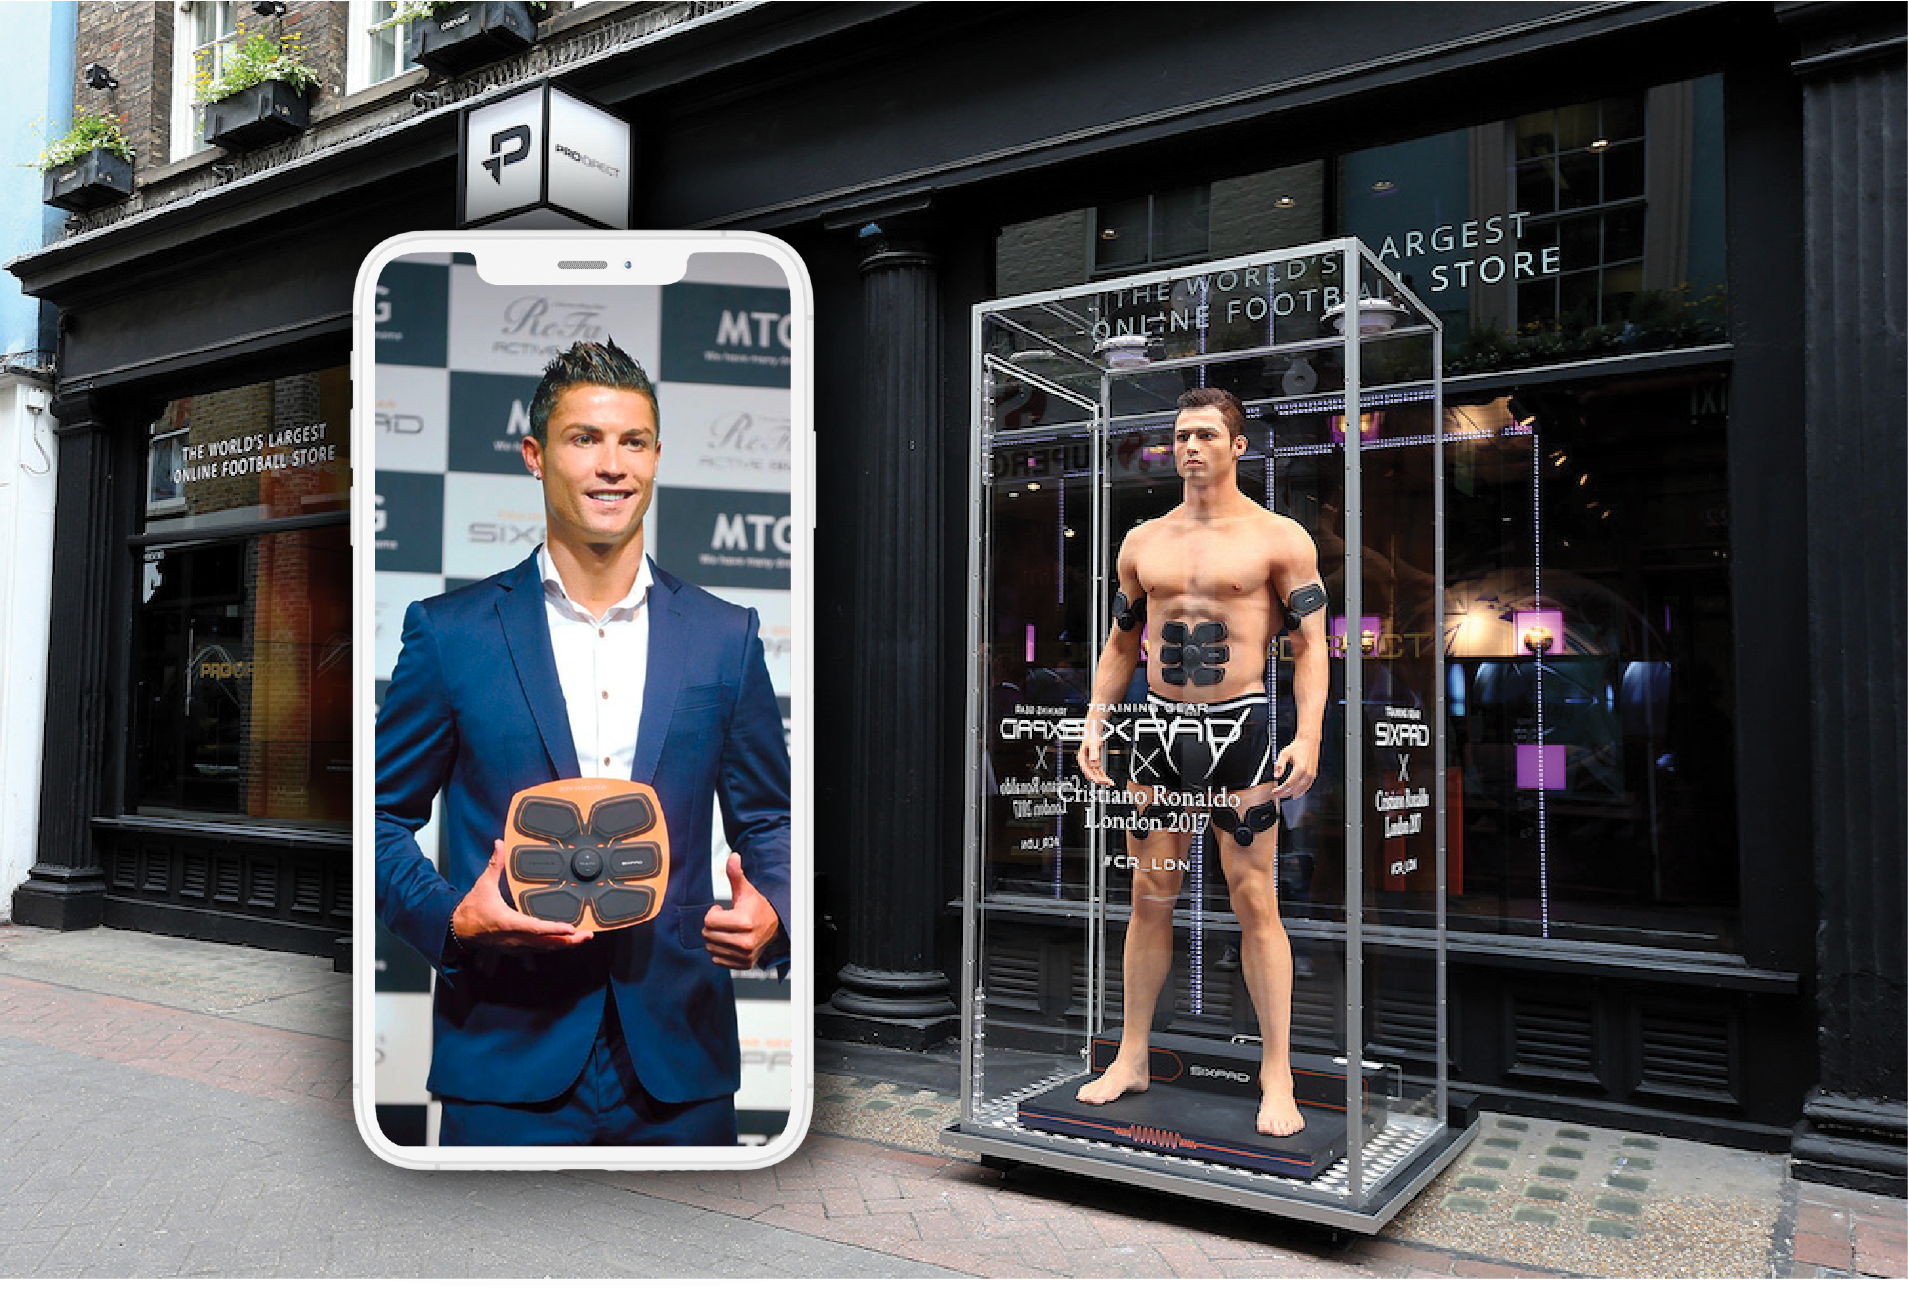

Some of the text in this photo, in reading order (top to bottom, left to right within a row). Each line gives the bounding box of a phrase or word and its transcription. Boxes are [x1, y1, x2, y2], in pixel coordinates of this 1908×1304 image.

[1114, 211, 1531, 309] THE WORLD'S ARGEST
[1091, 305, 1210, 344] ONLINE
[1430, 246, 1560, 292] STORE
[182, 422, 327, 461] THE WORLD'S LARGEST
[173, 444, 337, 484] ONLINE FOOTBALL STORE
[1088, 702, 1209, 716] TRAINING GEAR
[1057, 782, 1242, 808] Cristiano Ronaldo
[1084, 806, 1211, 834] London 2017
